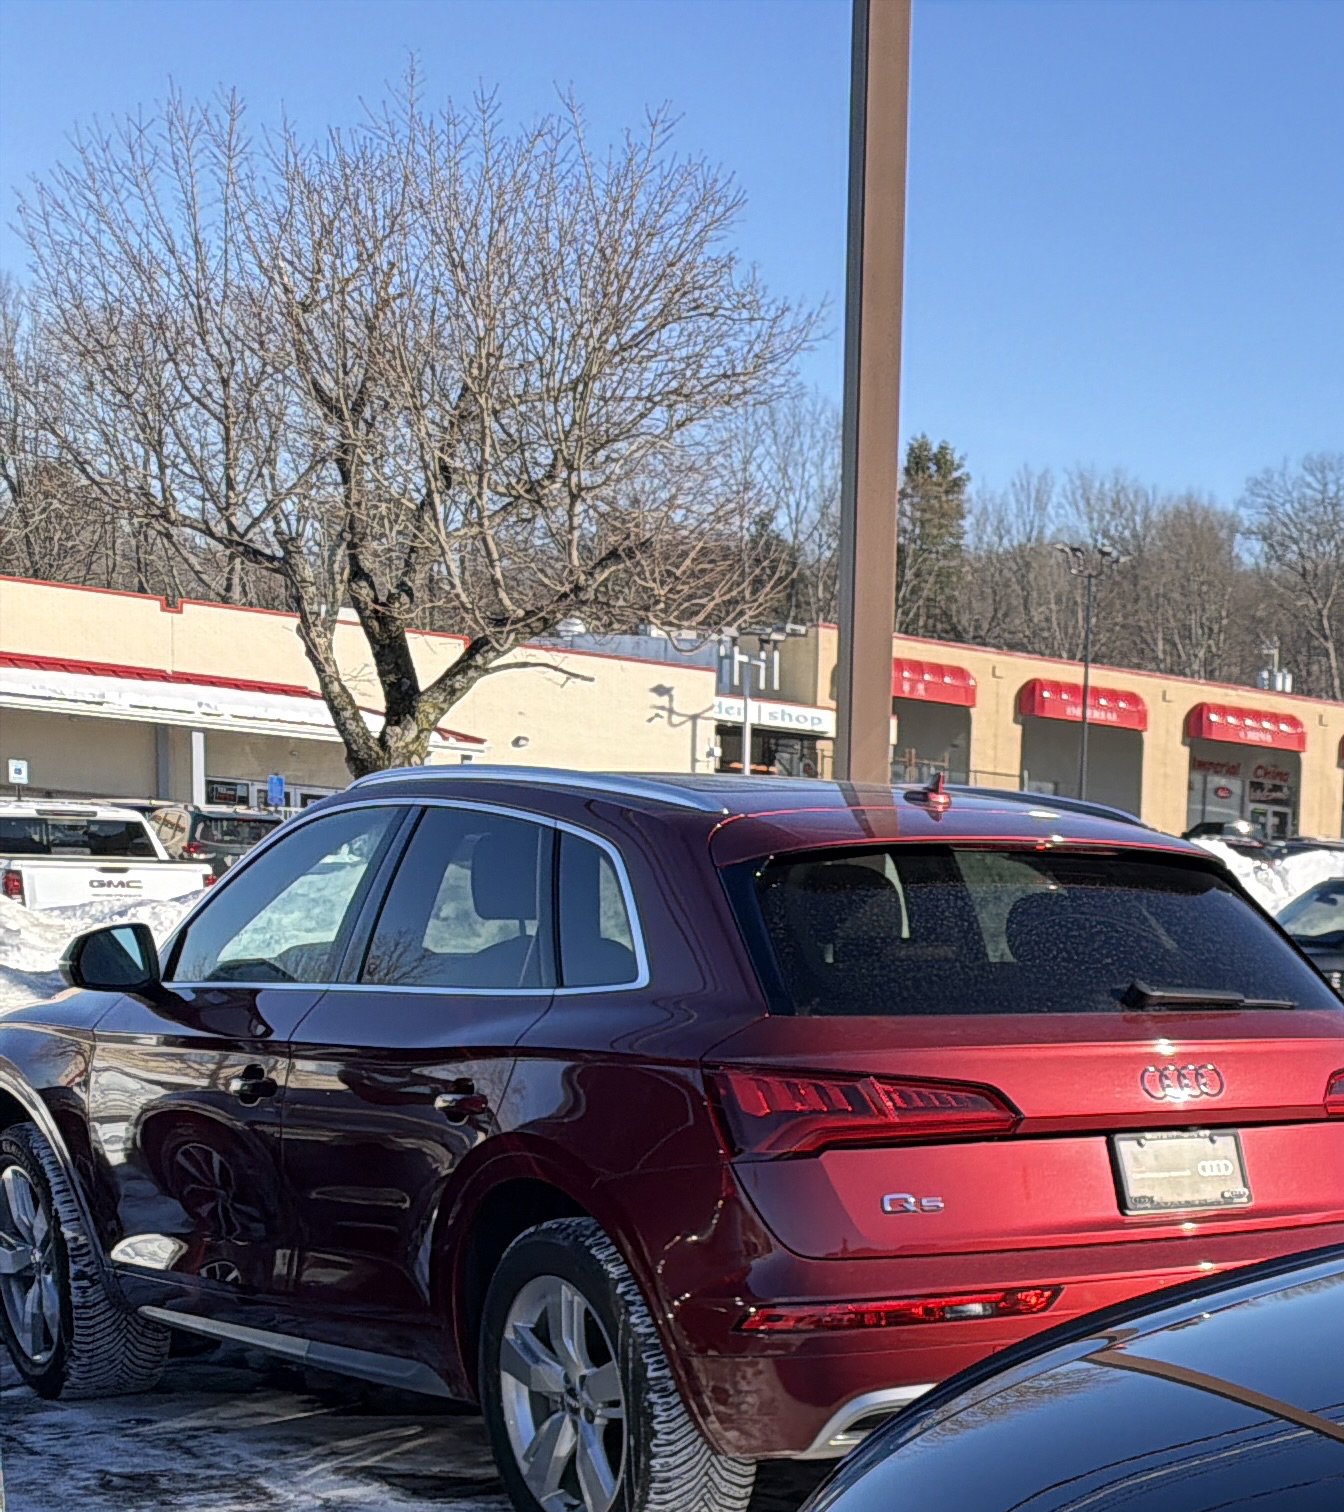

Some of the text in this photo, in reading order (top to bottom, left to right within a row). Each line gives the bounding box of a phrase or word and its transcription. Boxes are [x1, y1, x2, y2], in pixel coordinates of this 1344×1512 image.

[768, 709, 823, 727] shop
[89, 880, 143, 889] GMC
[882, 1193, 945, 1214] Q5
